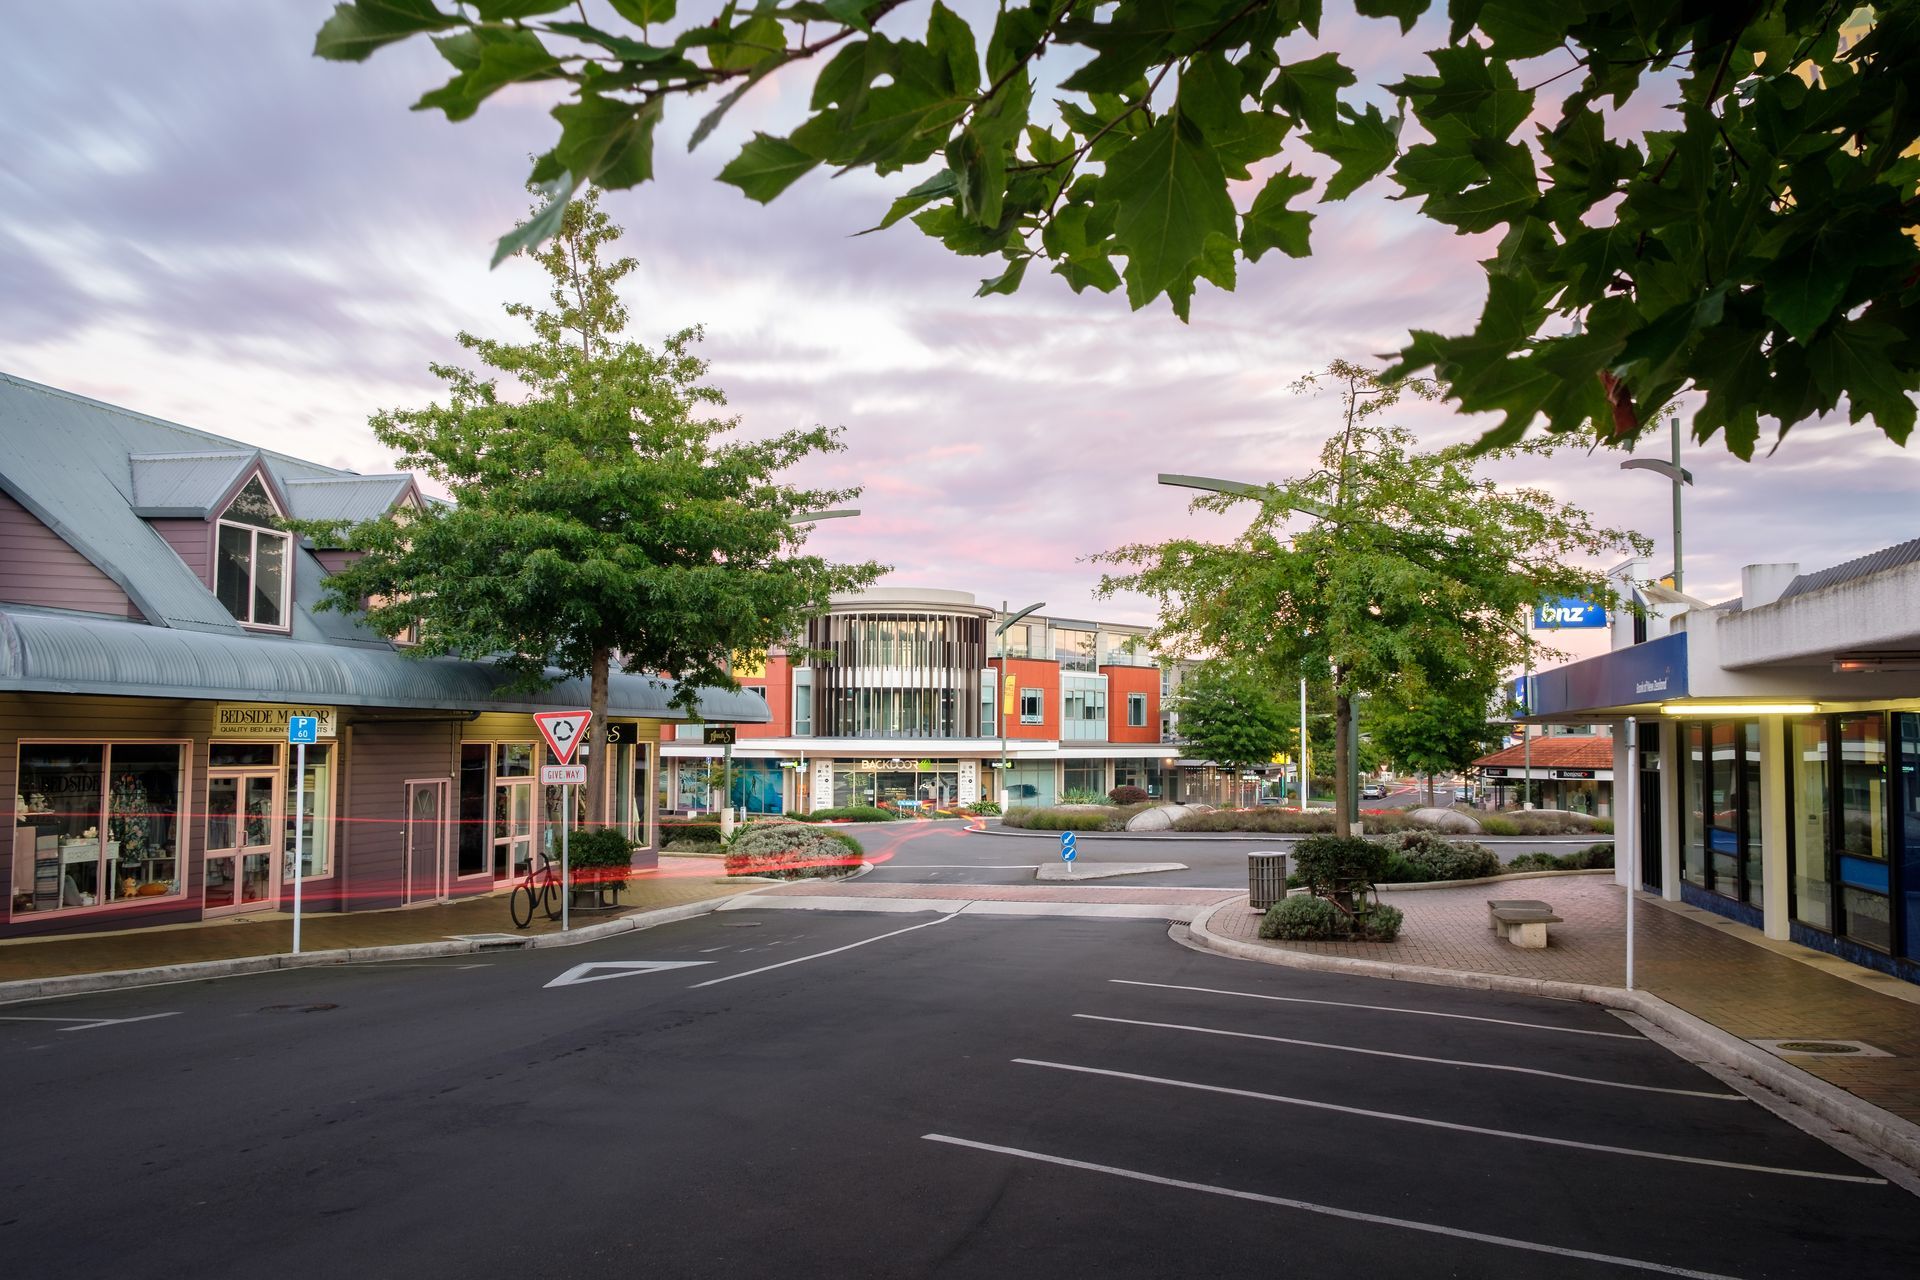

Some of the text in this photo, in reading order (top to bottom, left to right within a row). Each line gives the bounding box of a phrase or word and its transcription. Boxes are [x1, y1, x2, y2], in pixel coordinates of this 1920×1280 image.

[1541, 602, 1585, 622] bnz
[221, 709, 273, 723] BEDSIDE
[299, 718, 308, 728] P
[298, 729, 308, 738] 60
[861, 759, 919, 770] BACKDOOR
[547, 770, 580, 780] GIVE WAY
